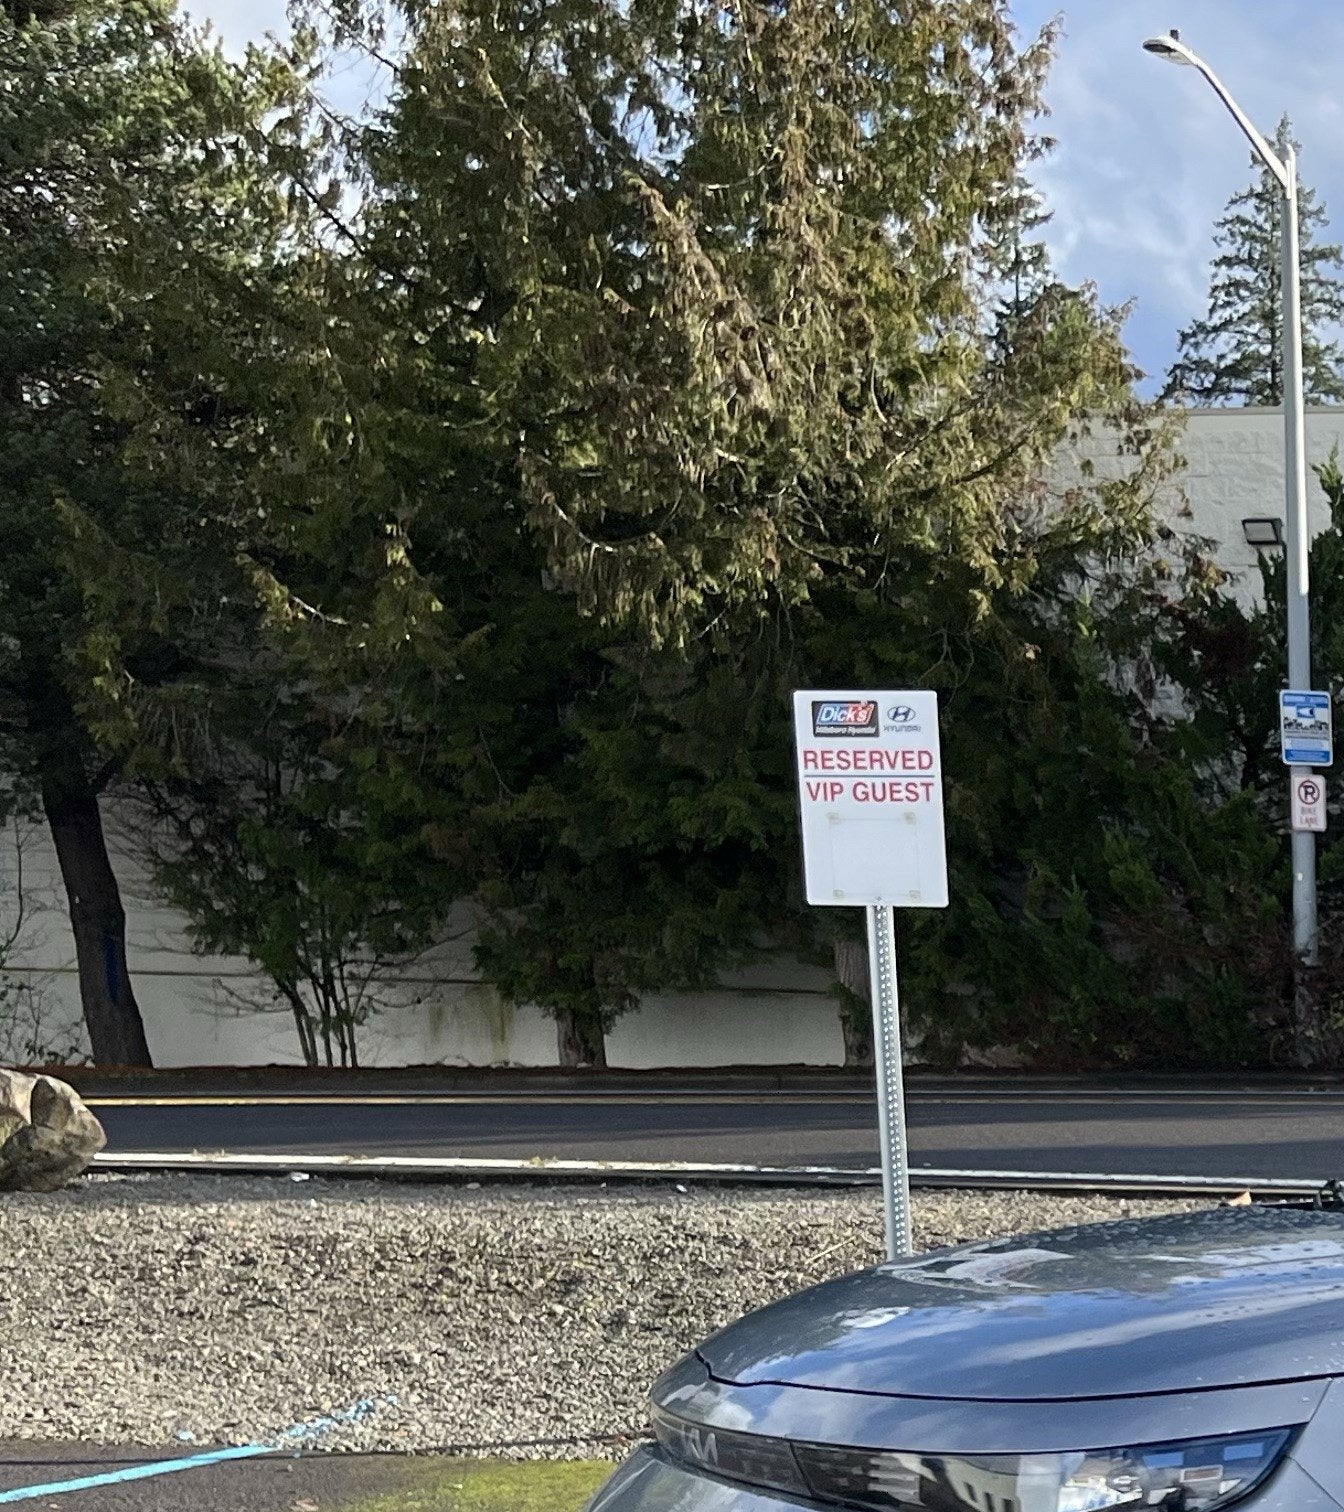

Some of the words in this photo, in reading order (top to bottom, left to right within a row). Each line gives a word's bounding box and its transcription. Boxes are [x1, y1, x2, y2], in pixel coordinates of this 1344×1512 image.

[803, 750, 934, 771] RESERVED
[806, 782, 844, 802] VIP
[852, 782, 934, 802] GUEST
